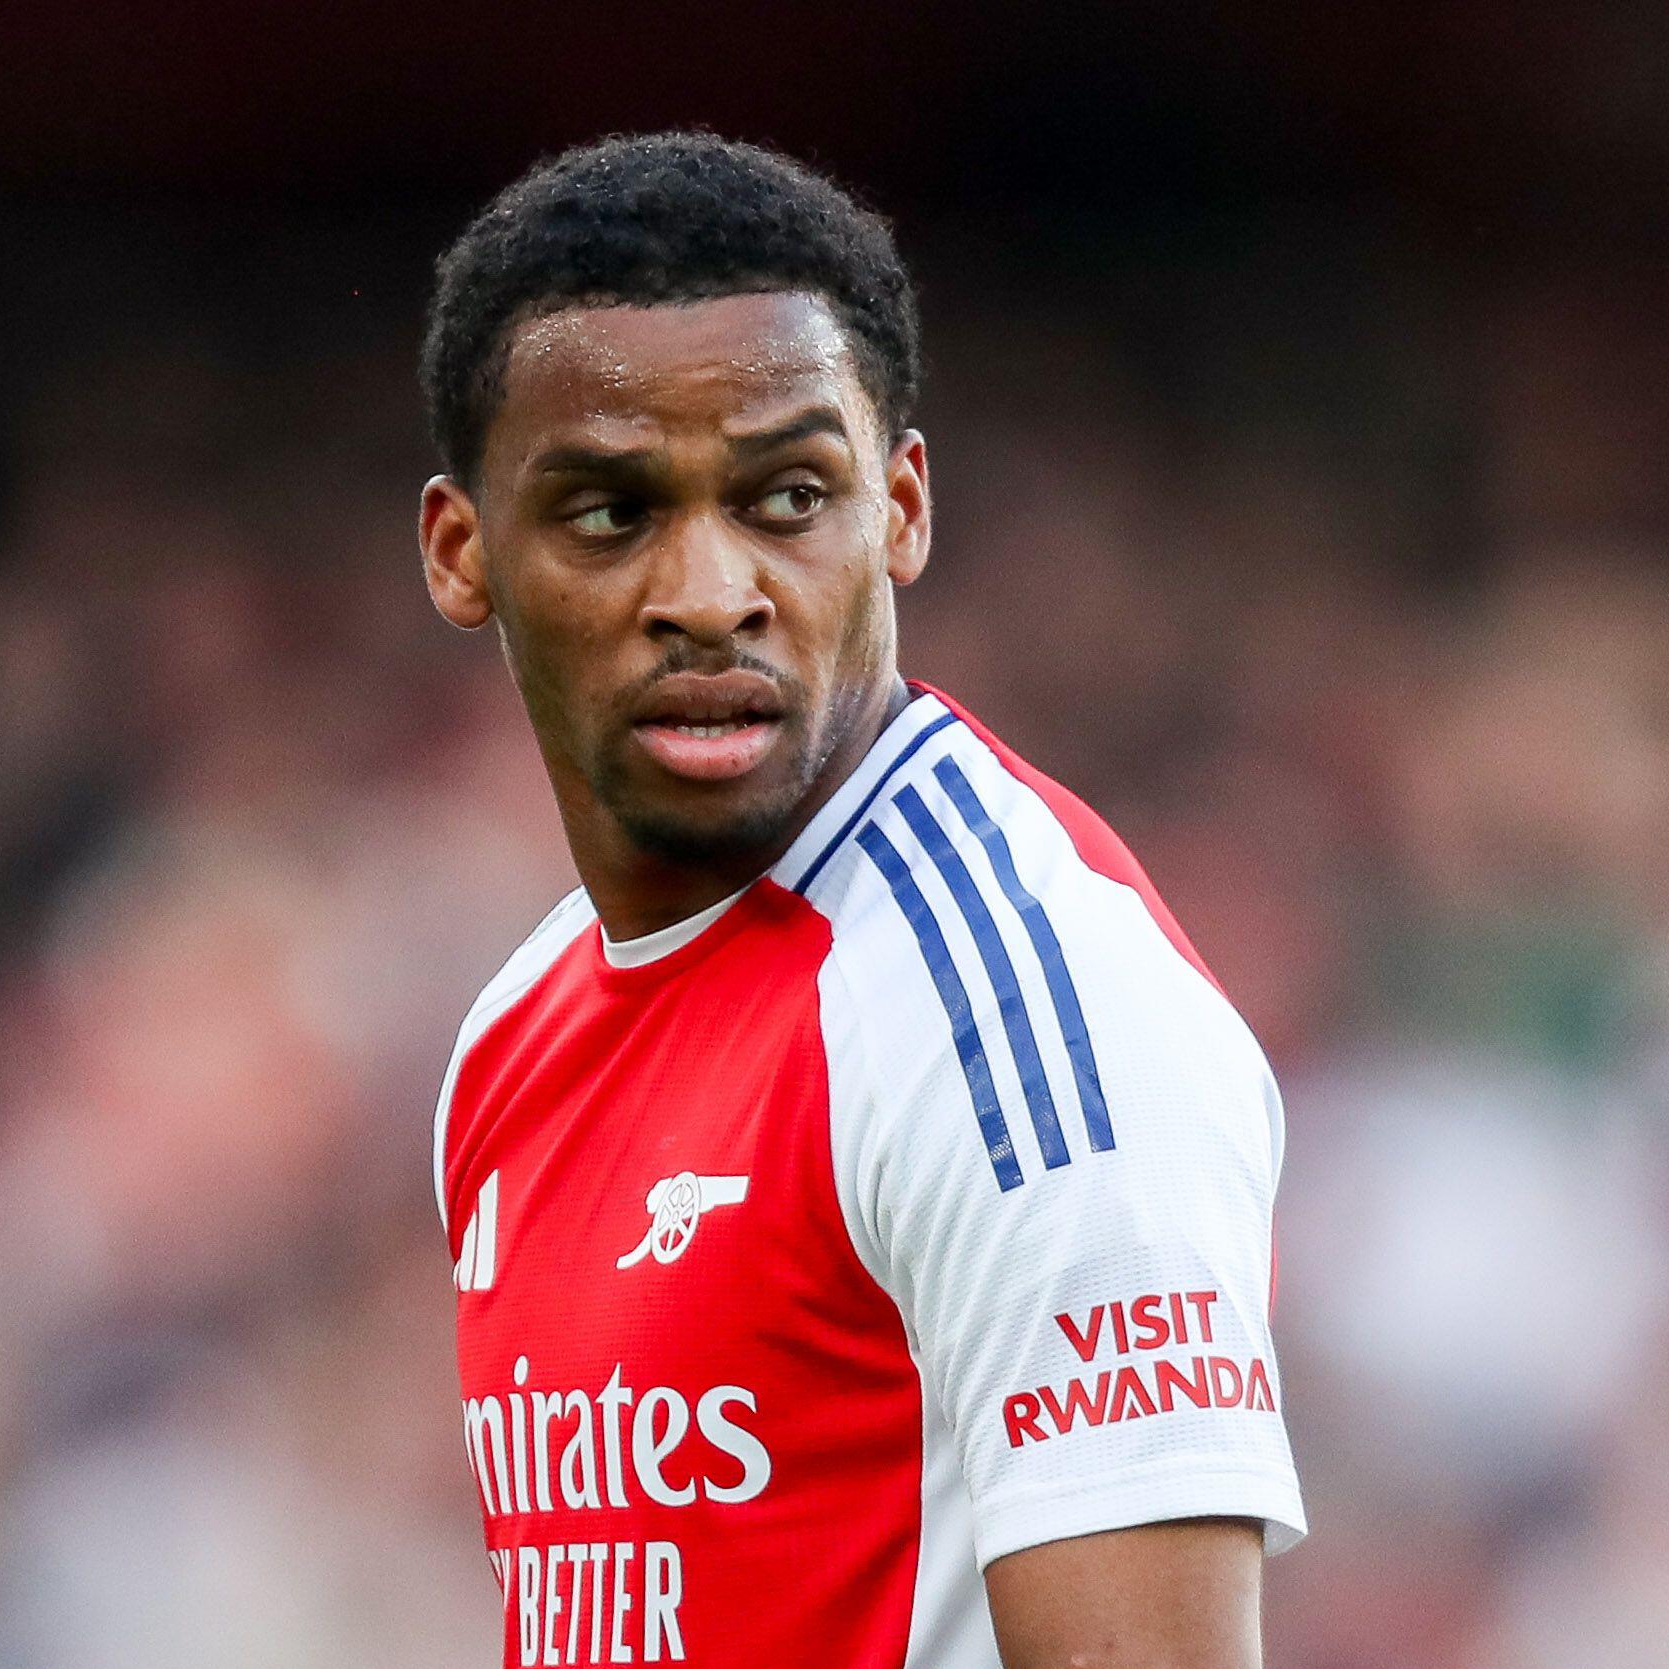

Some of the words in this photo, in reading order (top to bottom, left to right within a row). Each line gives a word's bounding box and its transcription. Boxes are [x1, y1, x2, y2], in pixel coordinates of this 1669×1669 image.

[1053, 1290, 1218, 1363] VISIT
[1002, 1356, 1276, 1449] RWANDA
[517, 1541, 686, 1667] BETTER
